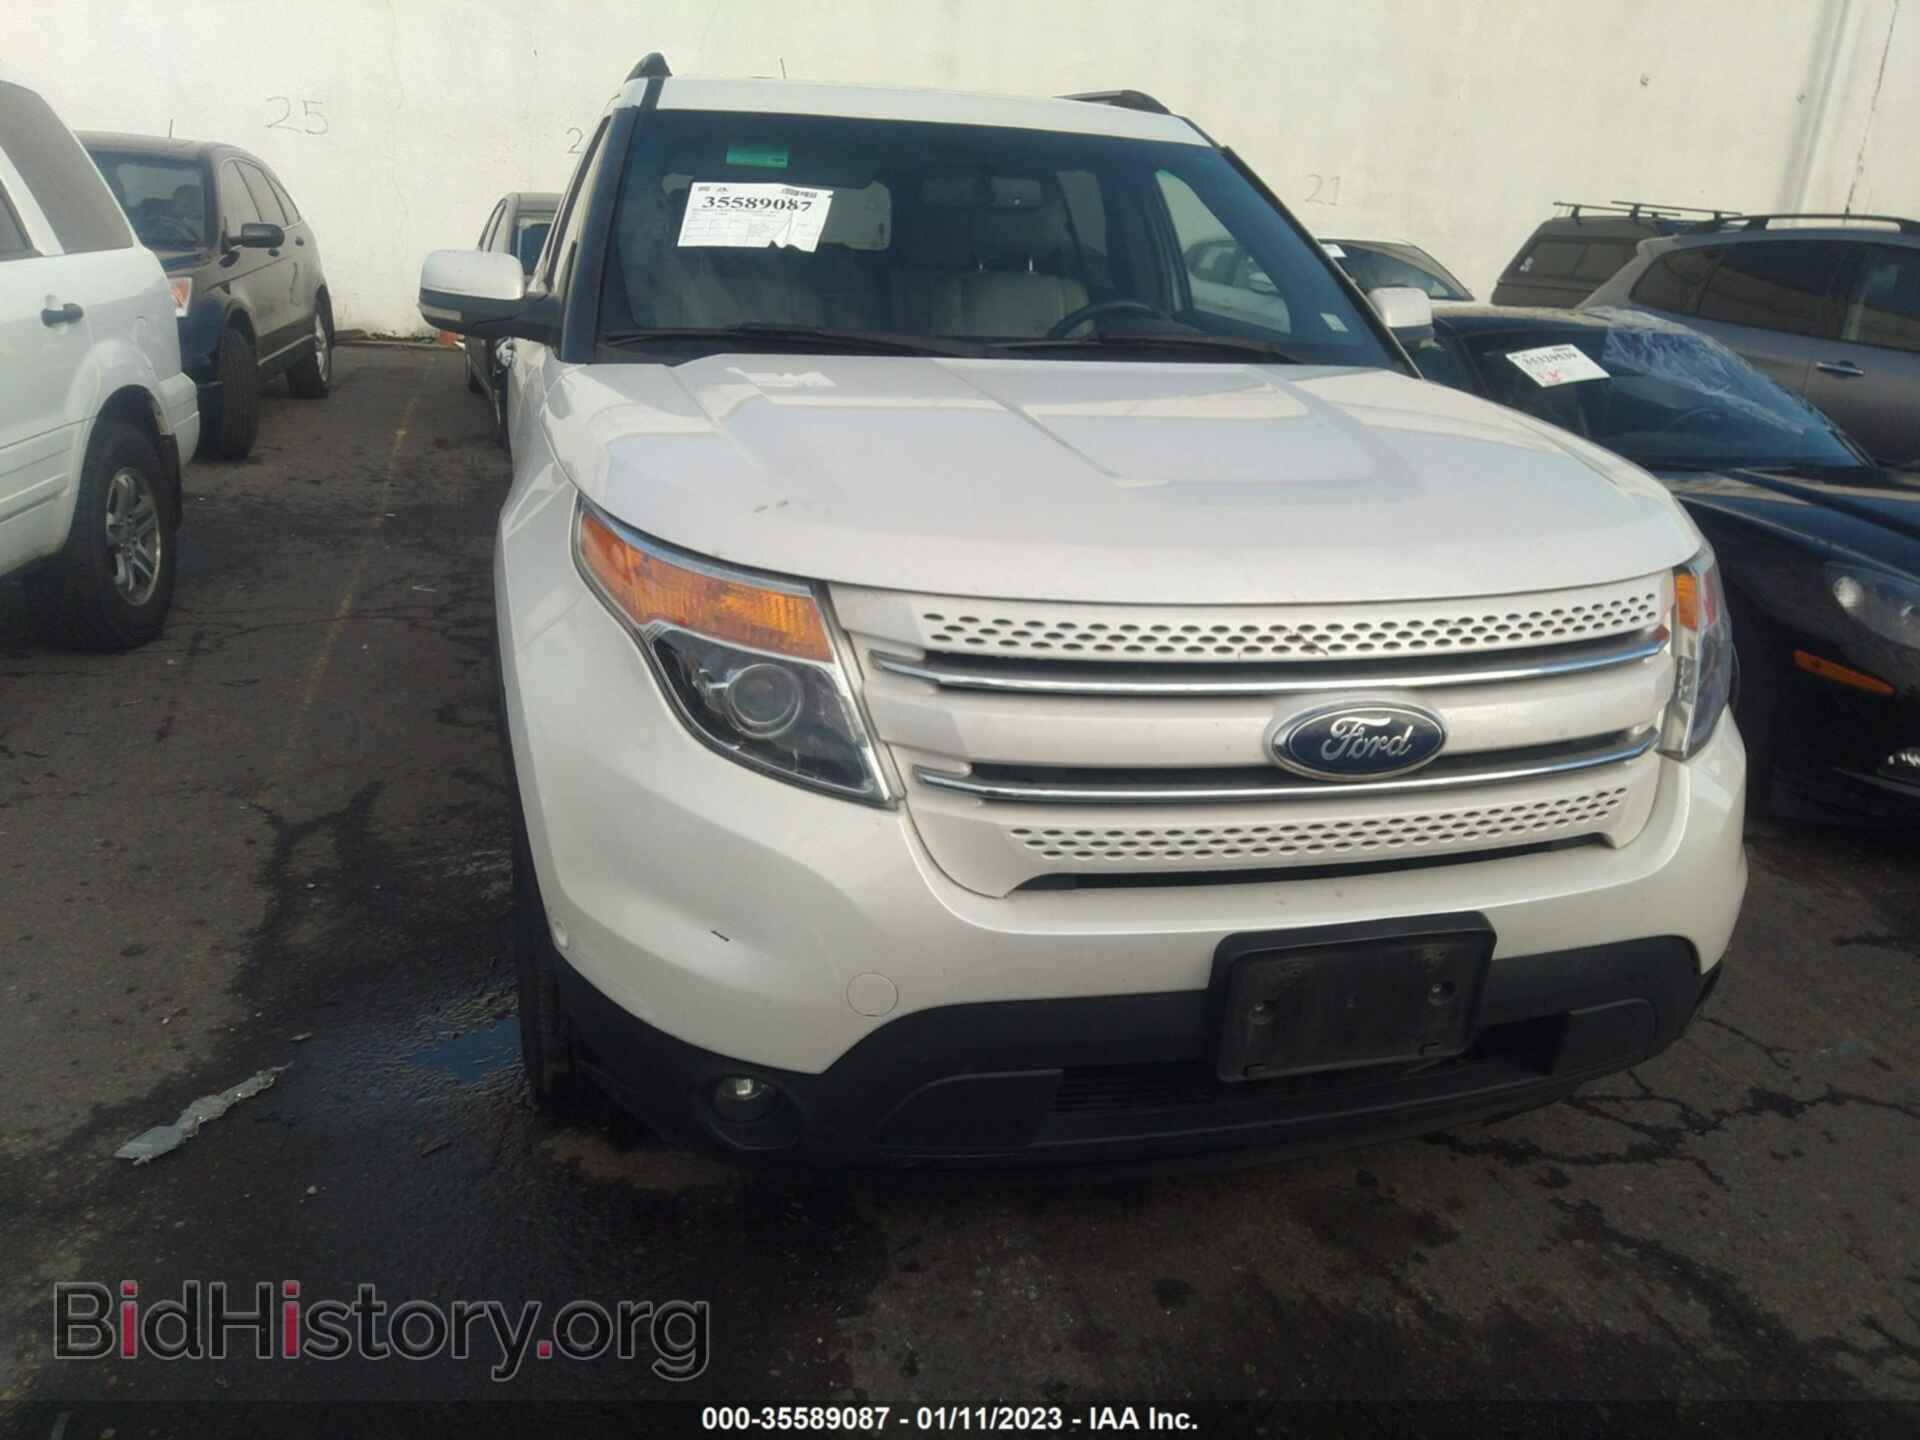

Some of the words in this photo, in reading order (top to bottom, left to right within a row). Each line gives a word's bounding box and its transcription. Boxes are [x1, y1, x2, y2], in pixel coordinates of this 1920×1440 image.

[263, 95, 329, 136] 25
[701, 195, 813, 213] 35589087
[1303, 173, 1341, 206] 21
[1321, 716, 1413, 761] Ford
